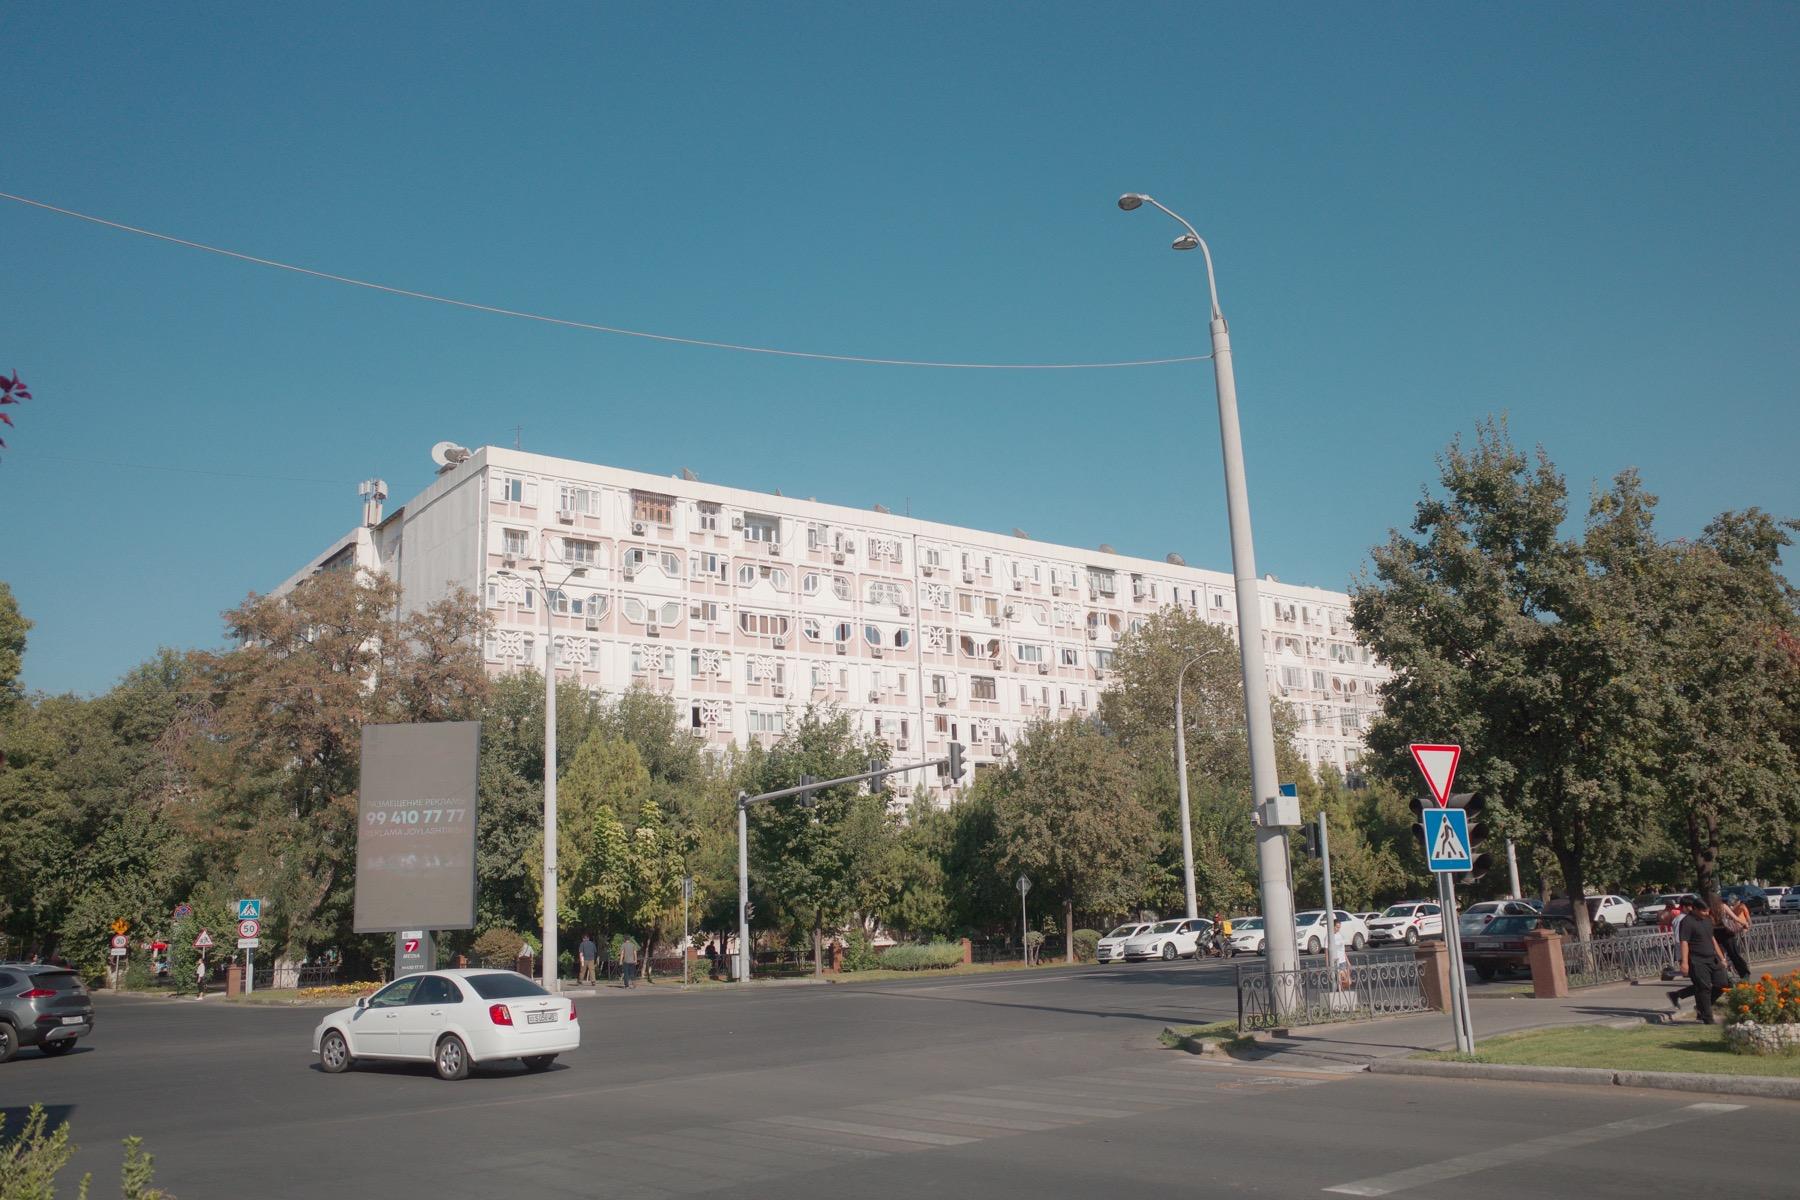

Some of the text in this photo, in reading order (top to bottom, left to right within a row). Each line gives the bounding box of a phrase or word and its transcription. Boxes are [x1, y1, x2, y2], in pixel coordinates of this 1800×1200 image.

[367, 799, 424, 809] ЗМЕЩЕНИЕ
[366, 808, 466, 825] 99 410 77 77
[243, 925, 255, 933] 50
[405, 942, 416, 952] 7
